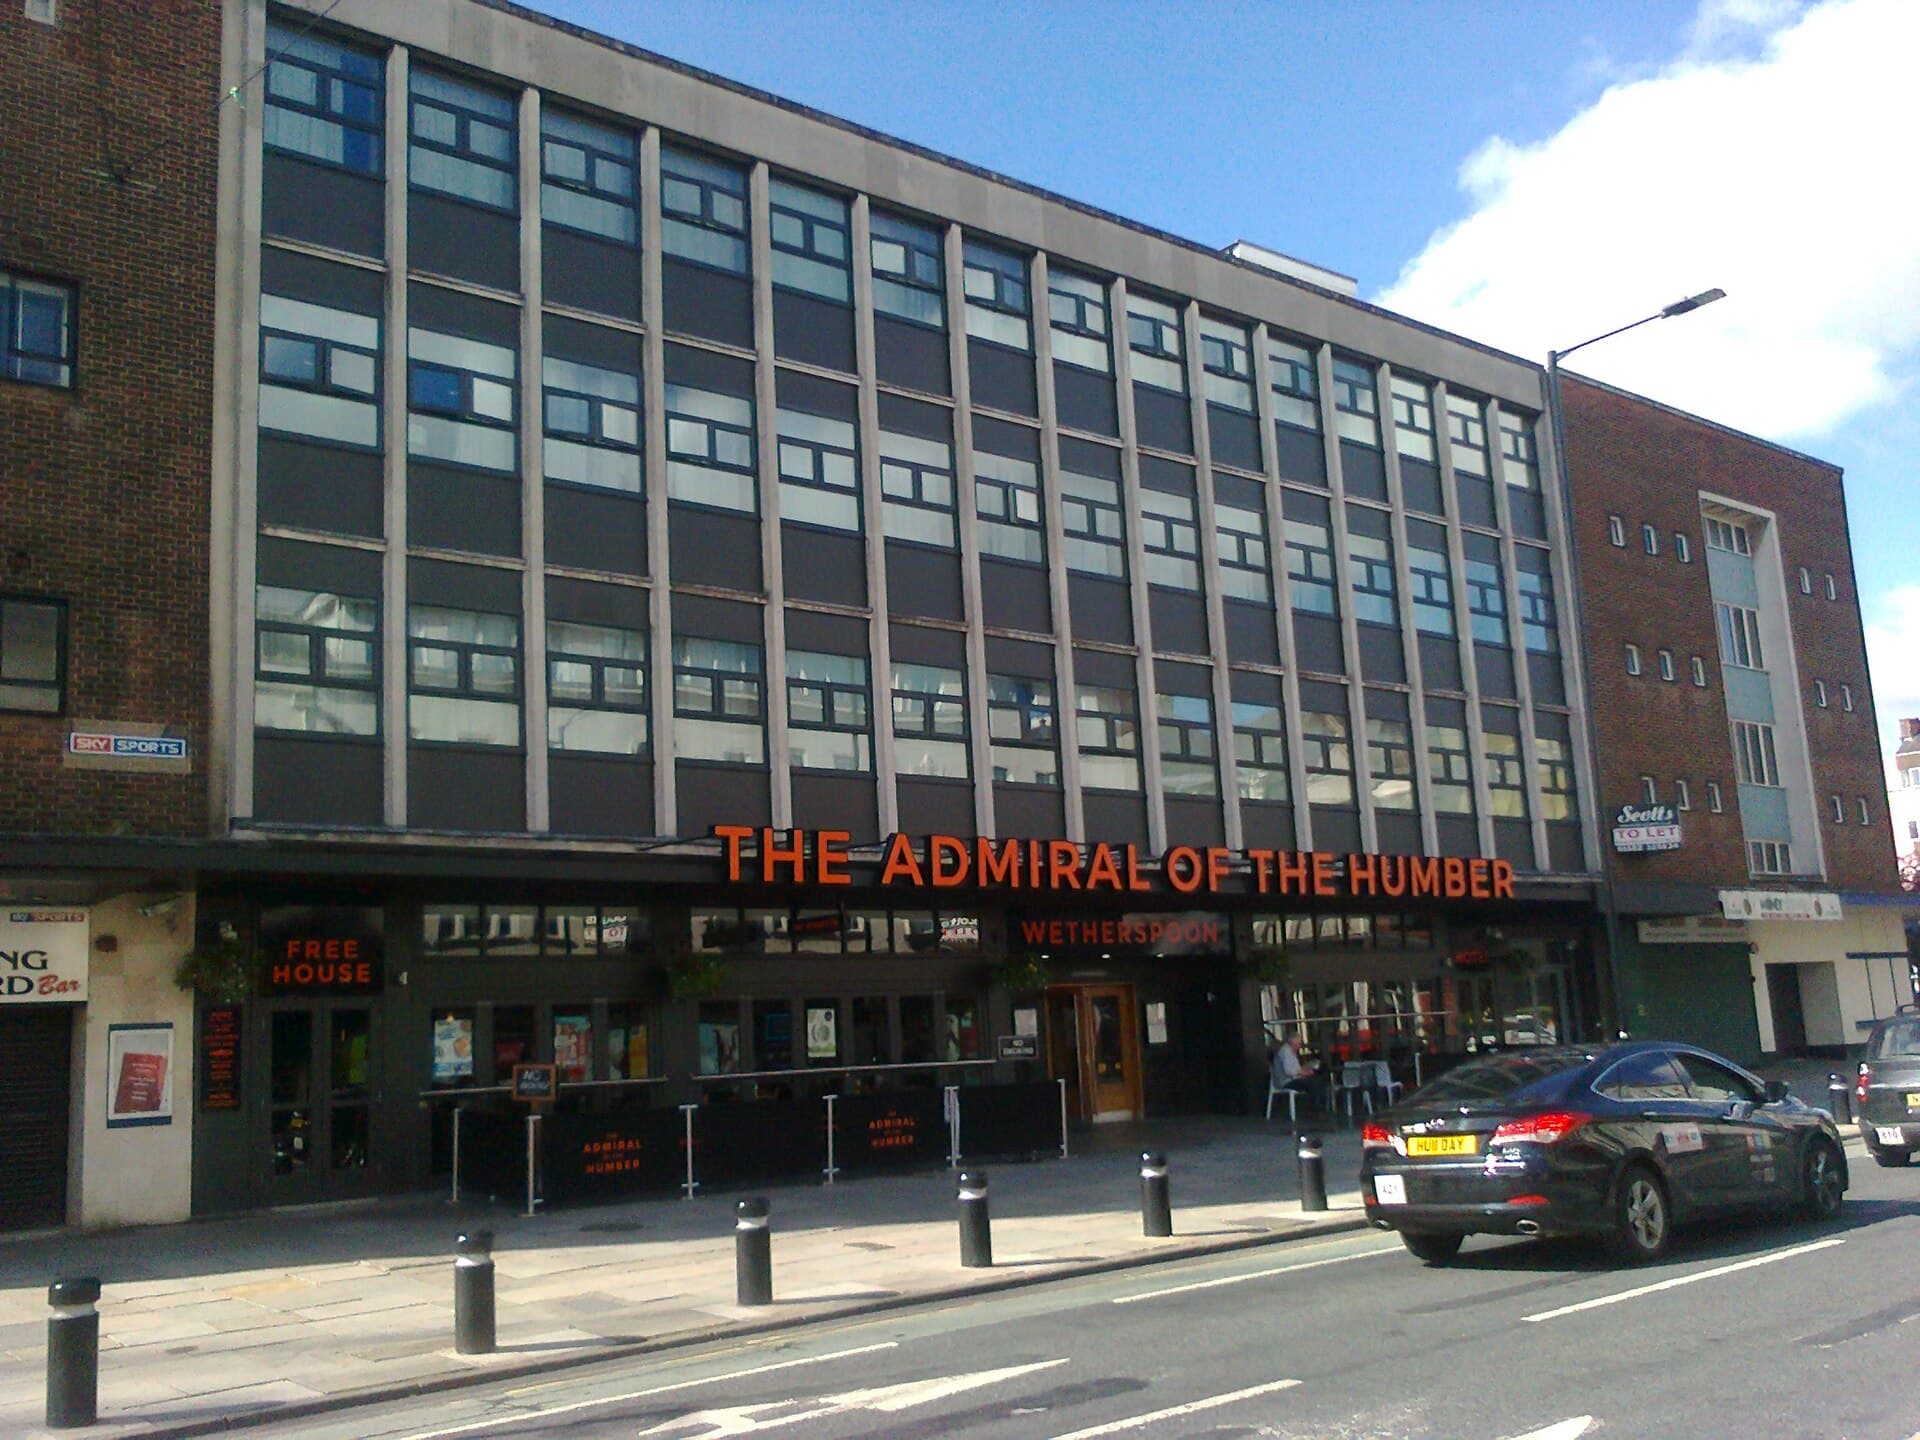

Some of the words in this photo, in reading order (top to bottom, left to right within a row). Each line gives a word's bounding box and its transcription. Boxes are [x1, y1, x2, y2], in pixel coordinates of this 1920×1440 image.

[75, 738, 109, 750] SKY
[117, 740, 180, 754] SPORTS
[1617, 828, 1640, 839] TO
[1646, 826, 1676, 838] LET
[714, 824, 852, 884] THE
[881, 832, 1151, 890] ADMIRAL
[1167, 846, 1230, 893] OF
[1247, 849, 1337, 896] THE
[1348, 854, 1515, 899] HUMBER
[1021, 920, 1218, 945] WETHERSPOON
[287, 939, 360, 960] FREE
[272, 962, 372, 984] HOUSE
[38, 974, 80, 996] Bar
[869, 1117, 916, 1129] ADMIRAL
[584, 1139, 641, 1153] ADMIRAL
[586, 1159, 640, 1174] HUMBER
